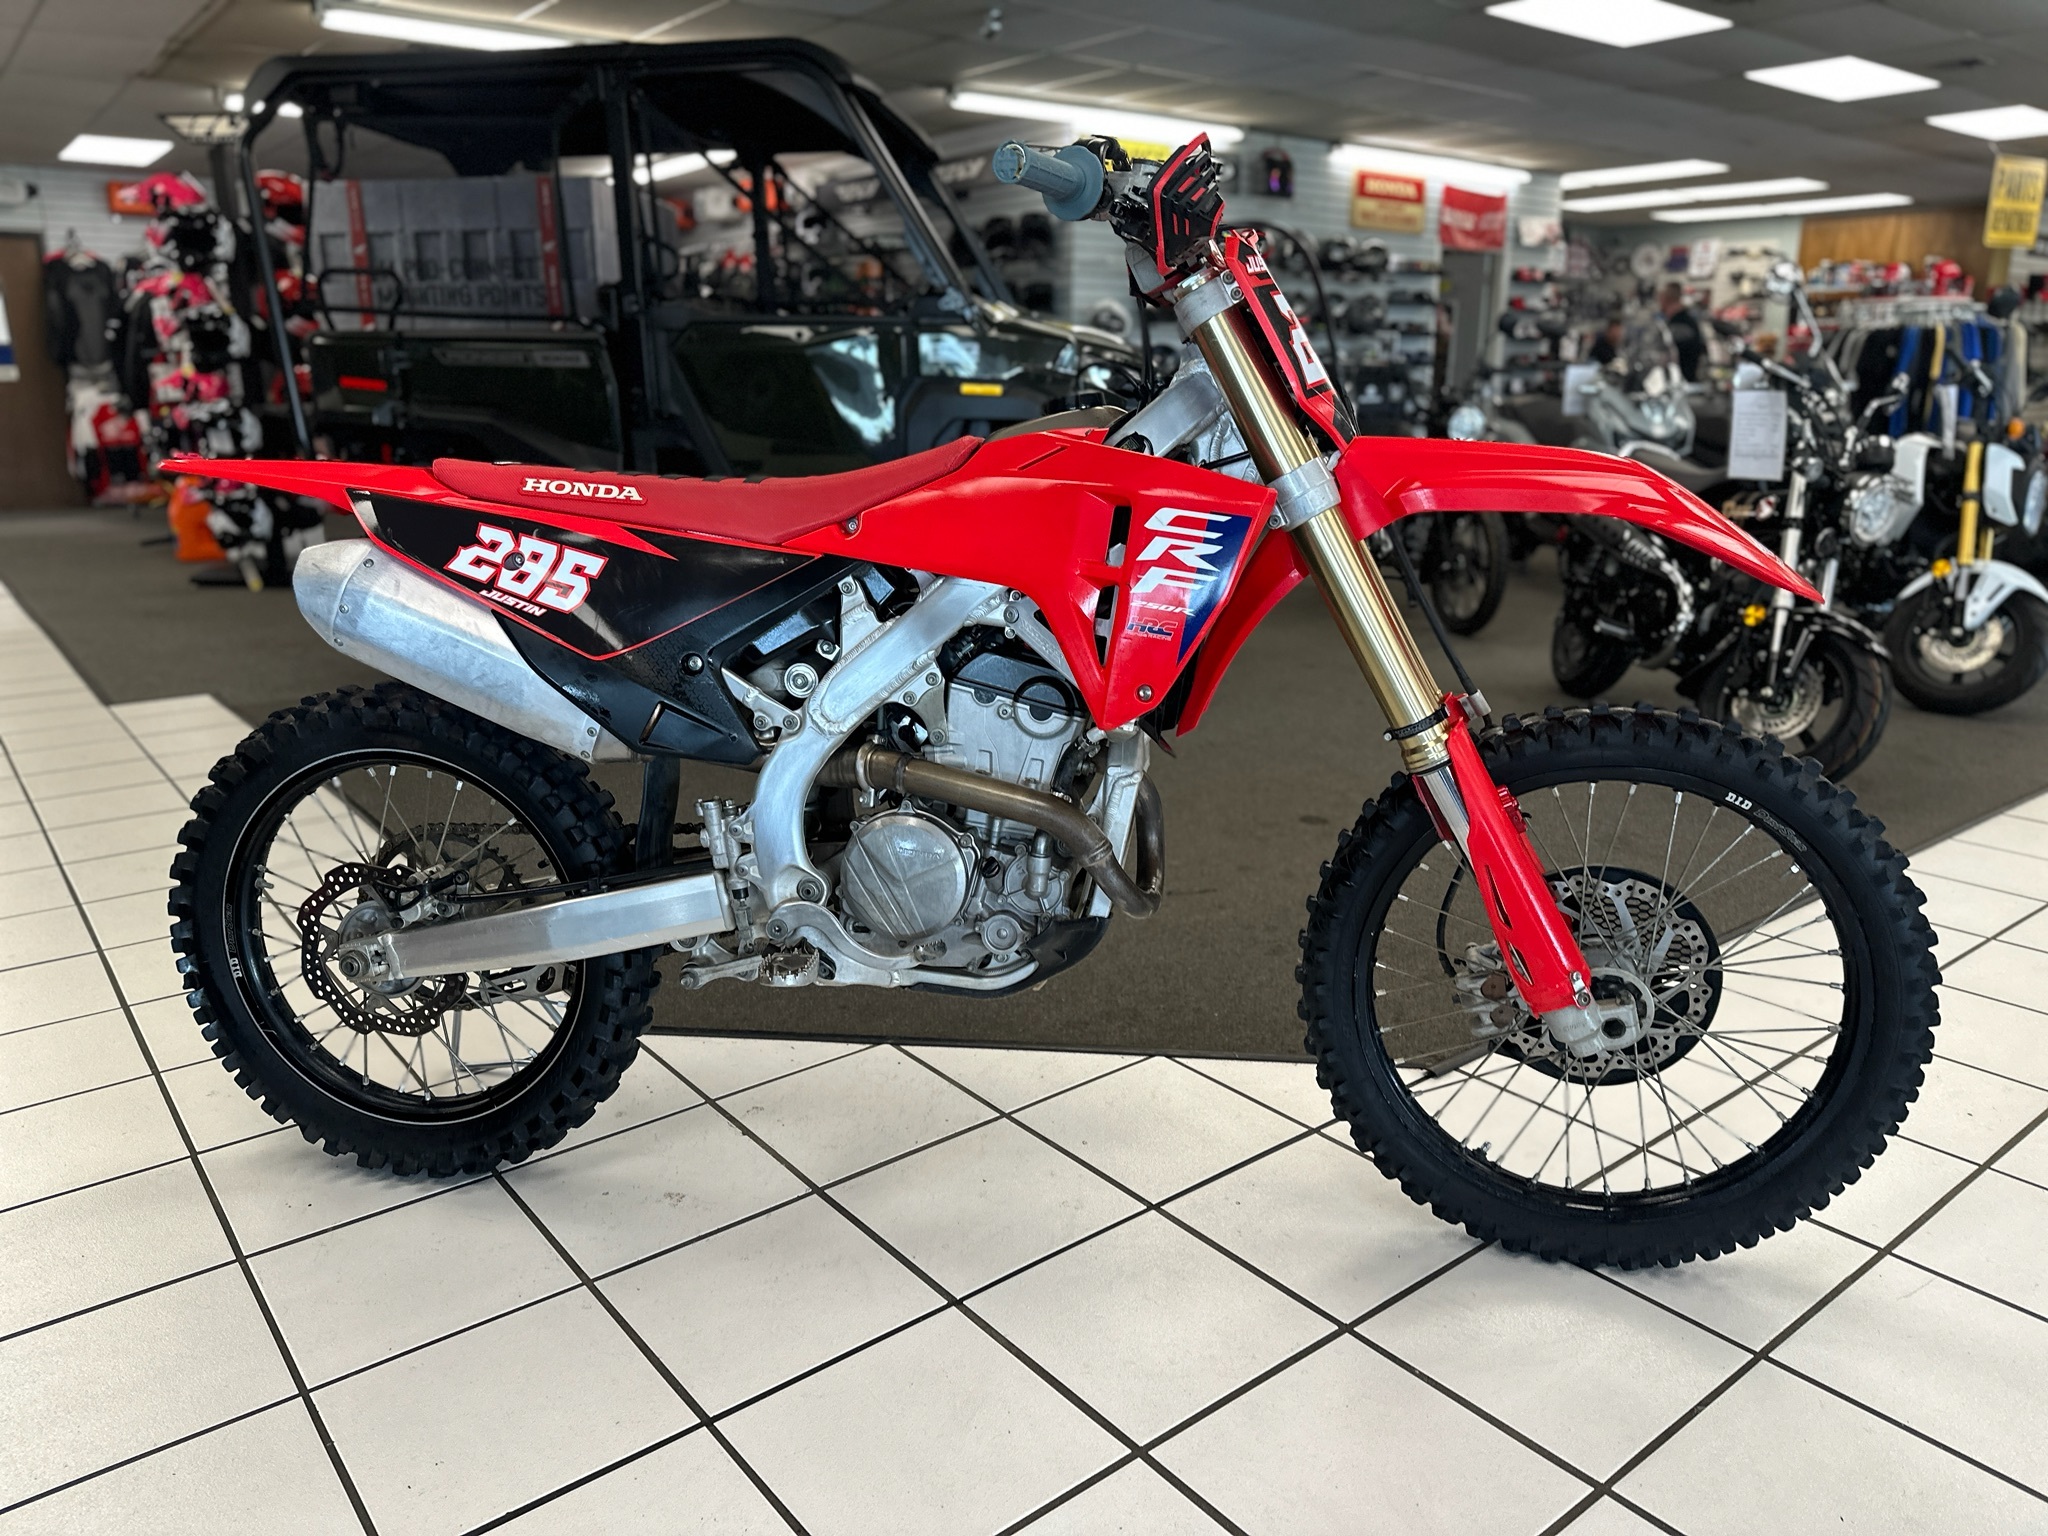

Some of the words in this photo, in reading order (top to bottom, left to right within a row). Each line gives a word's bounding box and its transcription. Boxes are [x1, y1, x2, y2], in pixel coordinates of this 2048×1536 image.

[522, 477, 643, 501] HONDA
[1130, 507, 1232, 594] CRF
[443, 522, 610, 615] 285
[478, 588, 548, 617] JUSTIN
[1130, 600, 1196, 617] 250R
[1127, 616, 1179, 637] HRC
